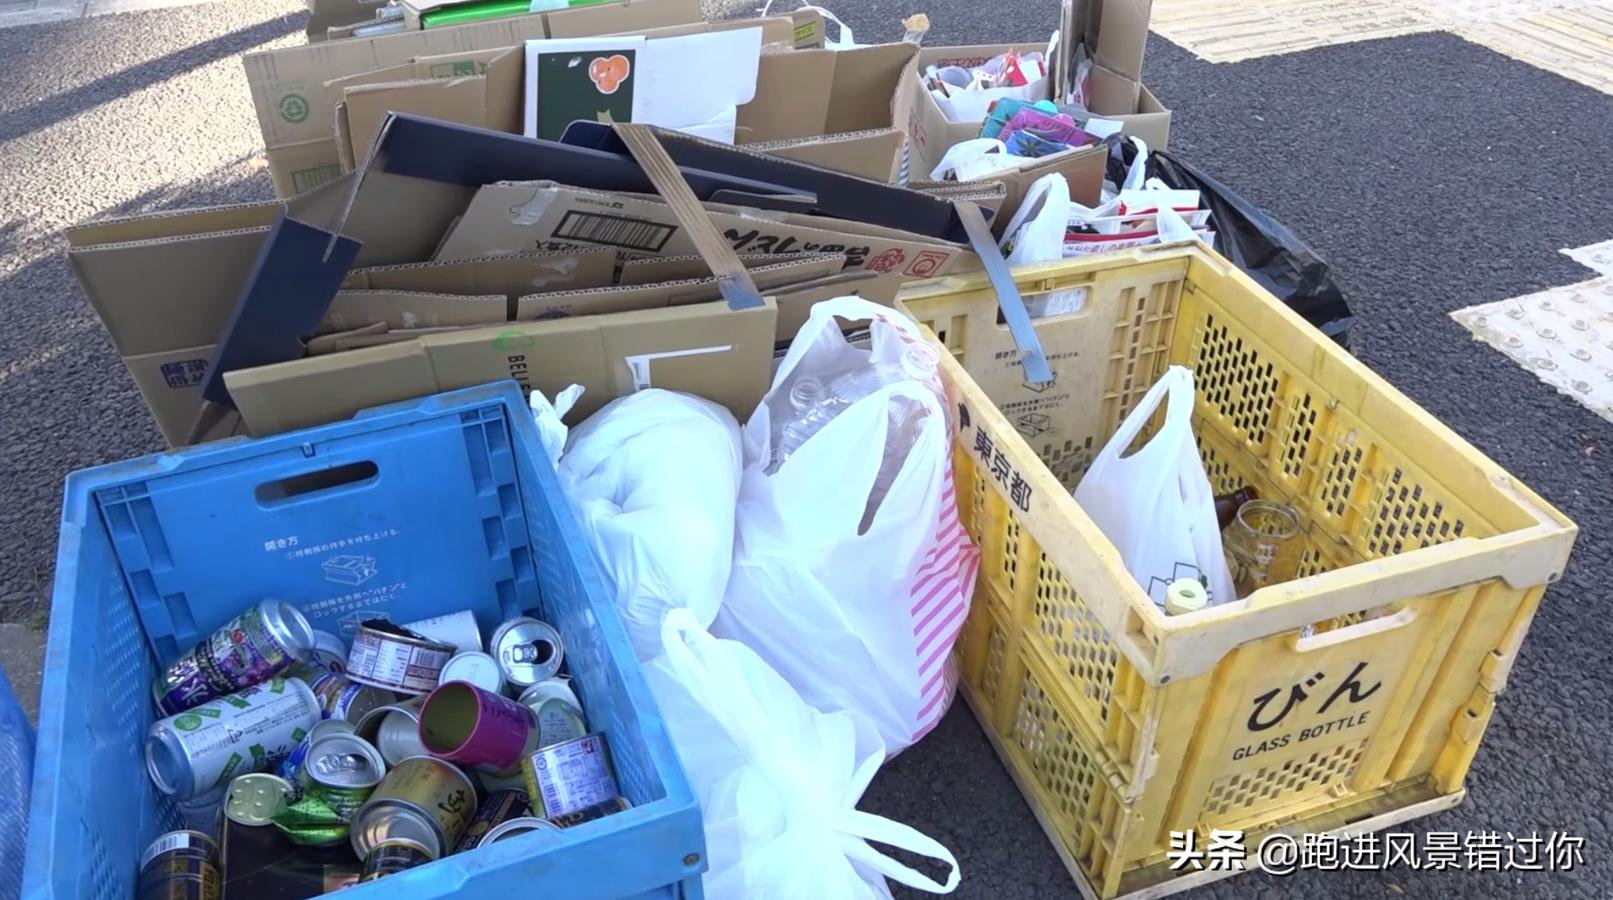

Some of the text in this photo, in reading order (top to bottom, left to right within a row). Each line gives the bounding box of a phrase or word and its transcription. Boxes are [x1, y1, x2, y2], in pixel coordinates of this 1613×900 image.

[974, 425, 1032, 513] 東京都
[1247, 662, 1382, 731] びん
[1232, 711, 1371, 760] GLASS BOTTLE
